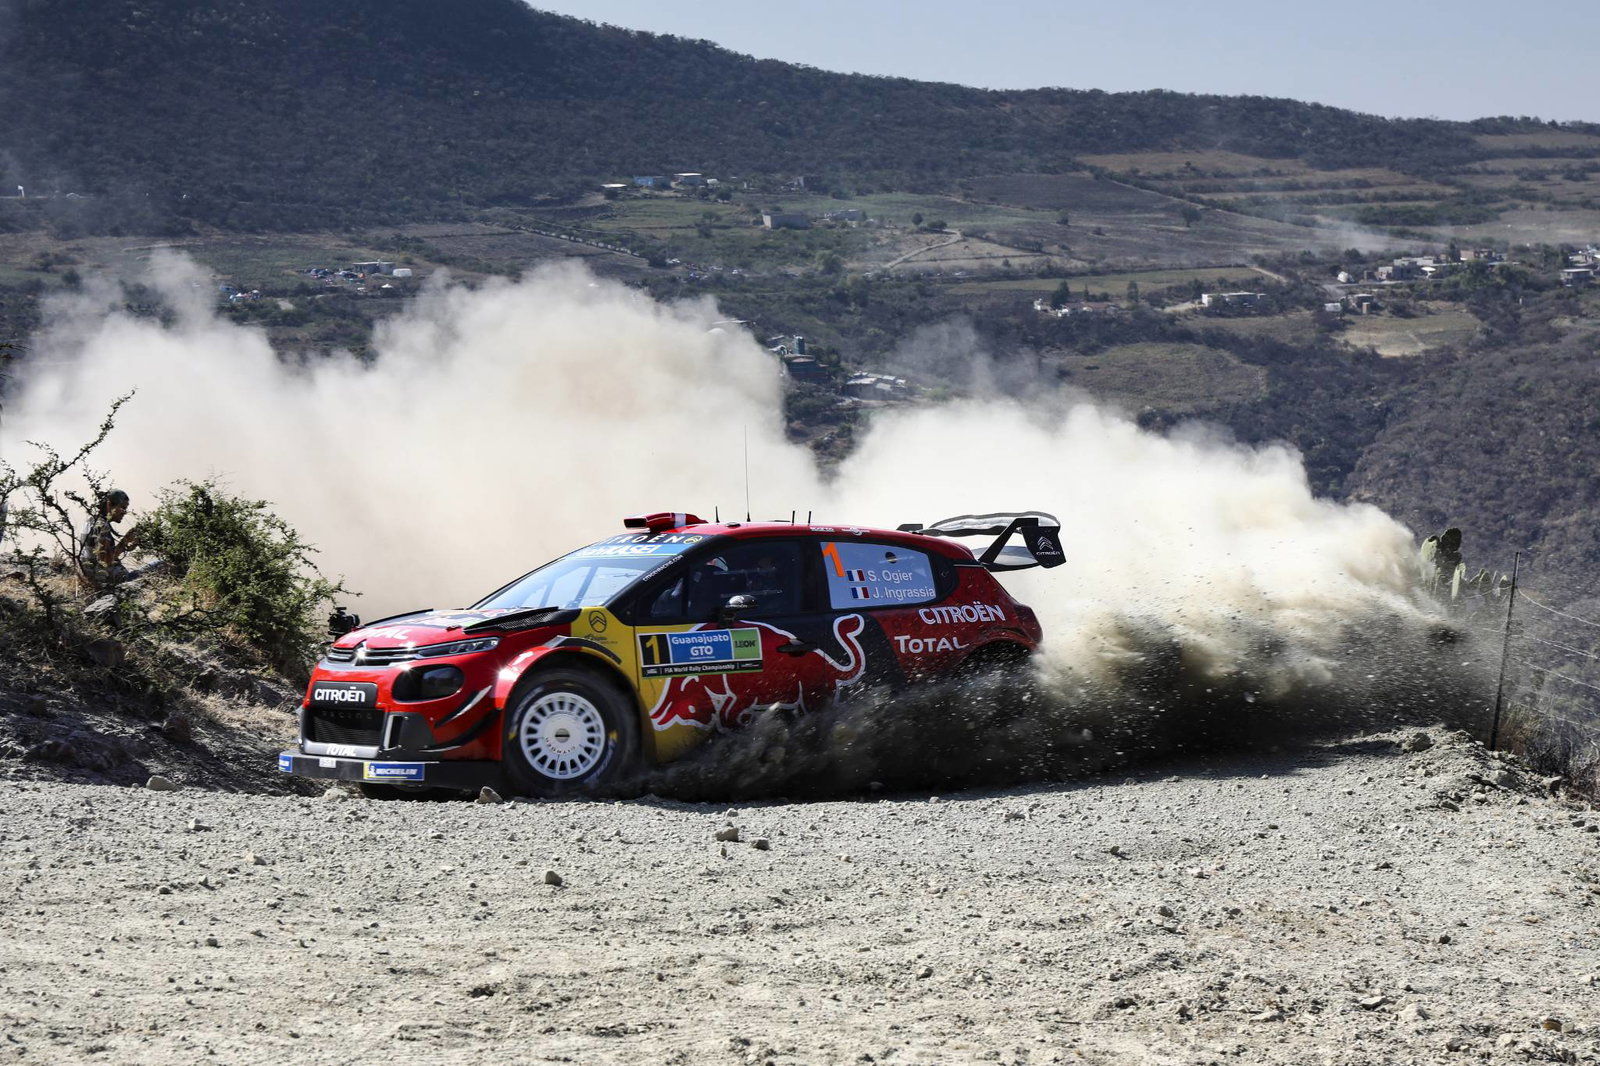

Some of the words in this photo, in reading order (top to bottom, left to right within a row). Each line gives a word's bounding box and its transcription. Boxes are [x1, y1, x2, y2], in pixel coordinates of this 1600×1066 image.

[822, 541, 845, 578] 1
[867, 570, 881, 581] S.
[882, 569, 913, 583] Ogier
[873, 587, 884, 599] J.
[885, 586, 936, 600] Ingrassia
[918, 601, 1006, 625] CITROËN
[671, 633, 730, 645] Guanajuato
[893, 635, 970, 654] TOTAL
[645, 635, 661, 665] 1
[690, 645, 714, 657] GTO
[689, 665, 702, 673] Rally
[702, 663, 736, 672] Championship
[314, 686, 366, 704] CITROËN
[325, 745, 358, 757] TOTAL
[375, 768, 418, 776] MICHELIN
